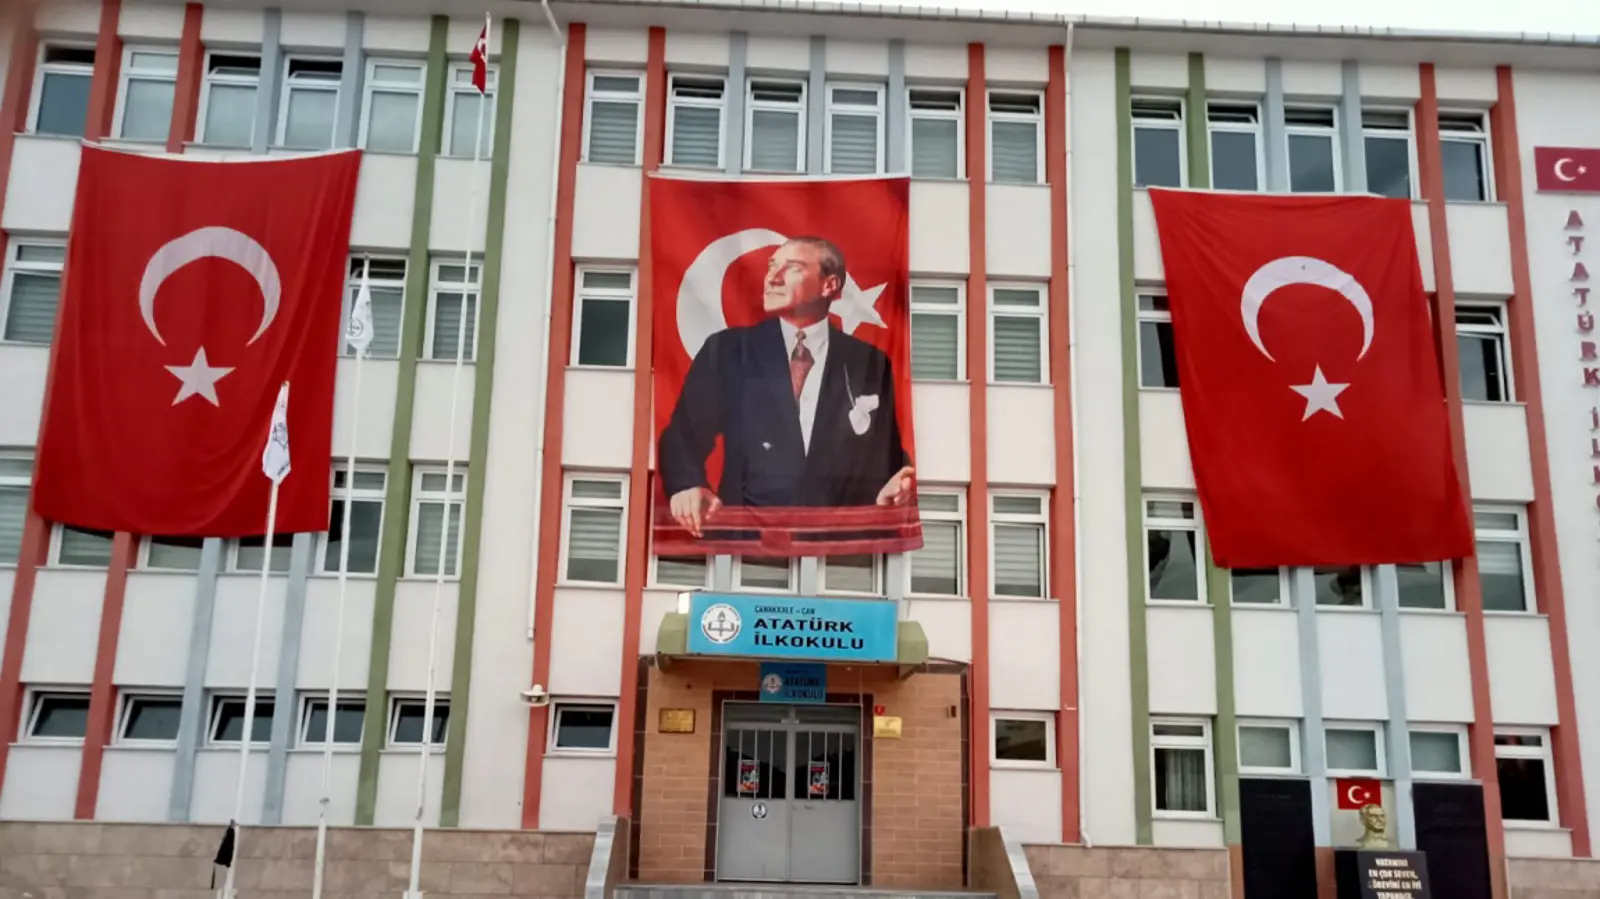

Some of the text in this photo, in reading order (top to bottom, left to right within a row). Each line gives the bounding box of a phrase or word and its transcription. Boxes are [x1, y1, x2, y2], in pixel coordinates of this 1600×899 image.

[1565, 210, 1600, 387] ATATÜRK
[753, 617, 854, 633] ATATÜRK
[754, 632, 864, 650] İLKOKULU
